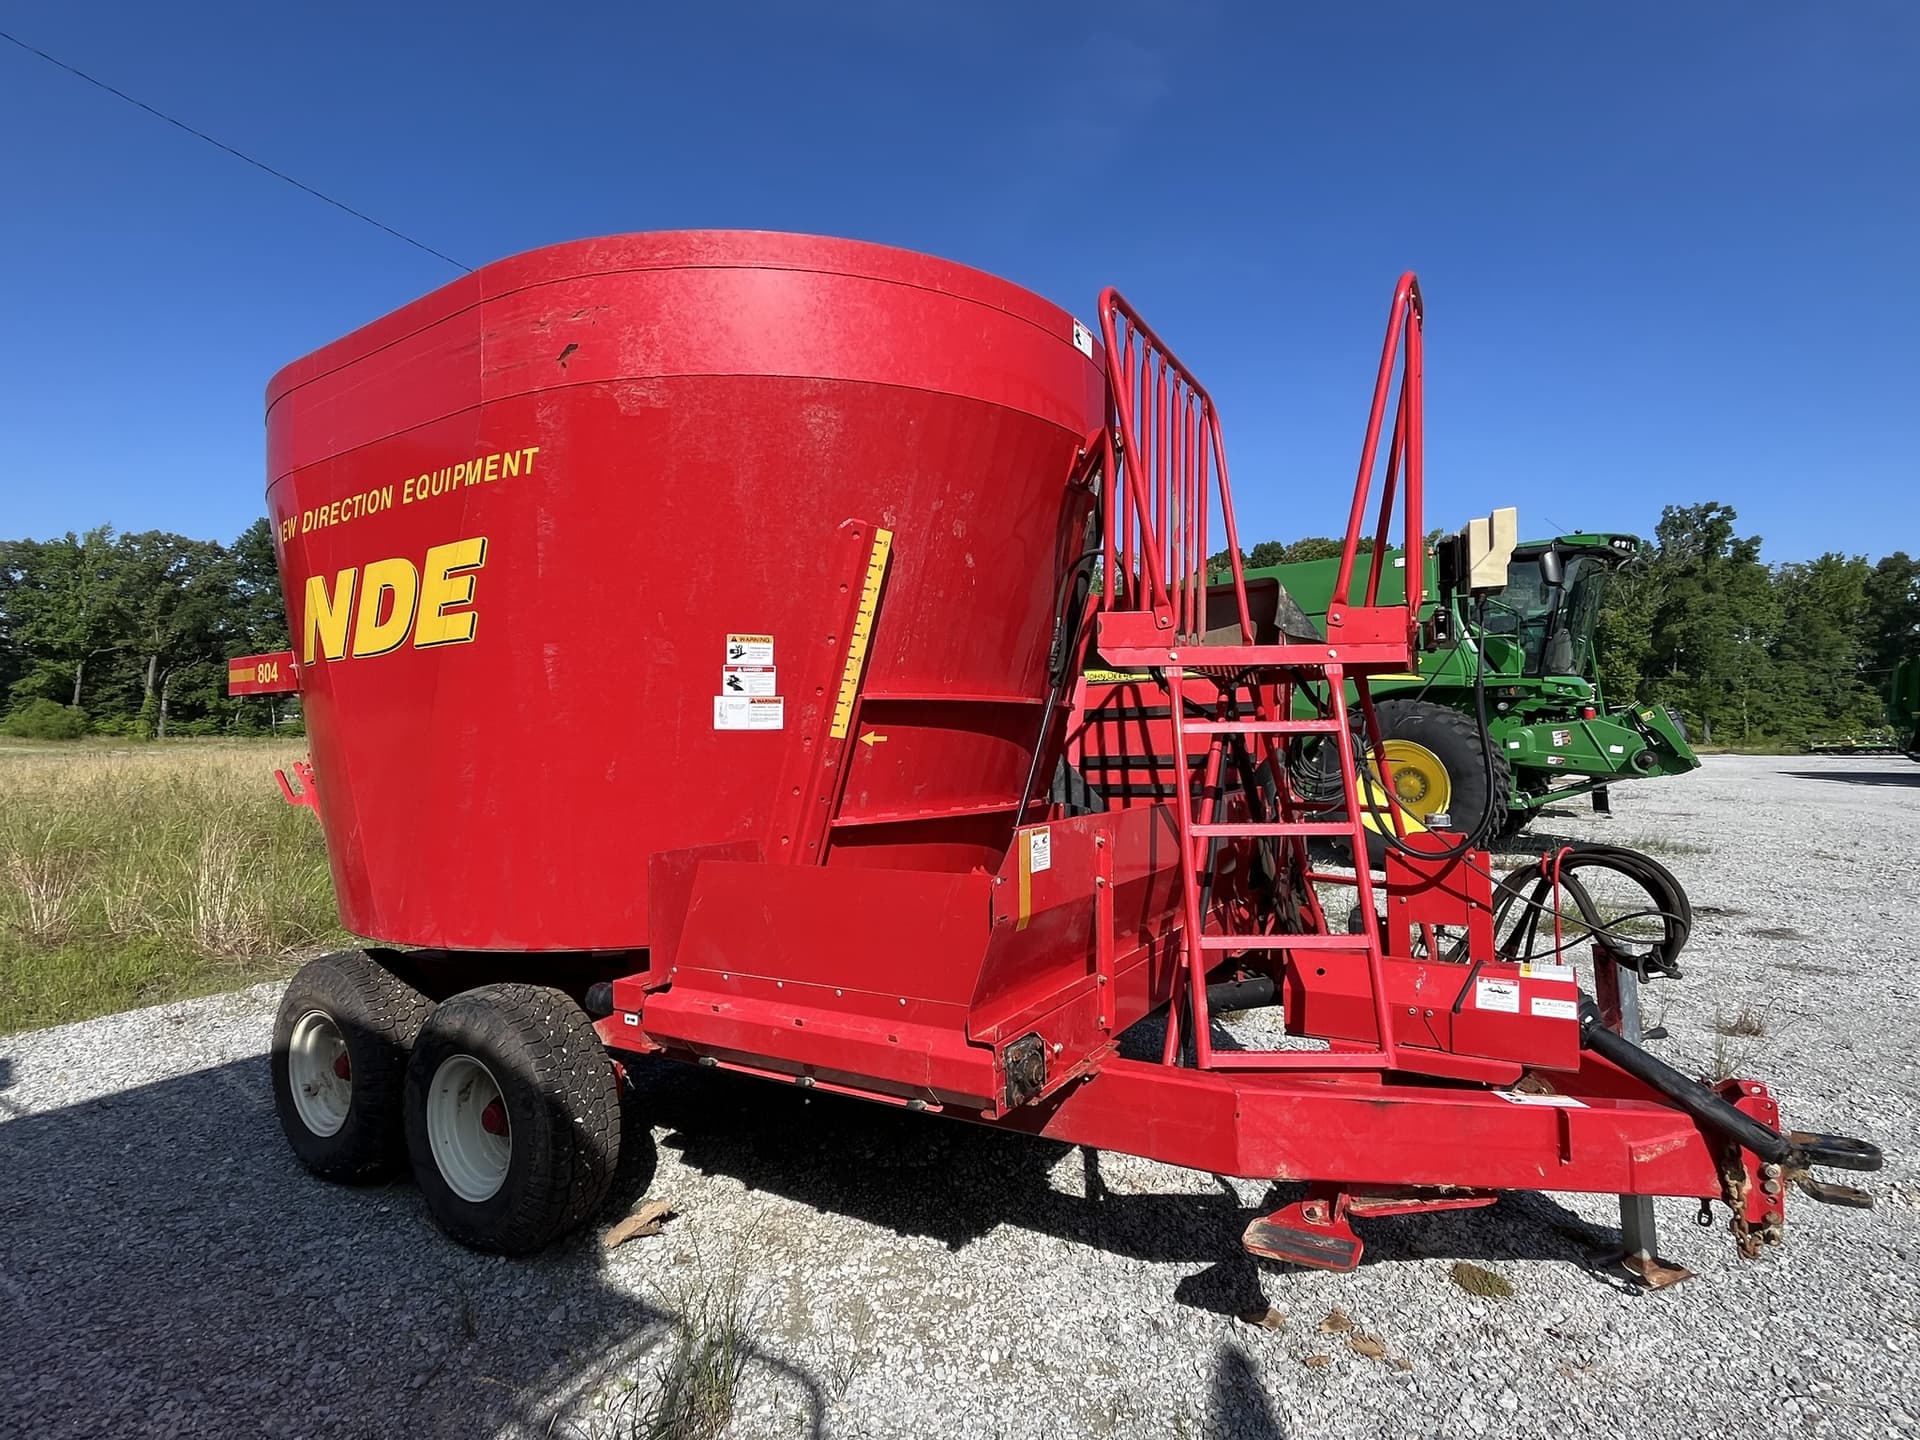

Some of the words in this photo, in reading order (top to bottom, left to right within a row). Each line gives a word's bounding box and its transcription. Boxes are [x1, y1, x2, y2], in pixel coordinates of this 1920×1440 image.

[301, 485, 394, 534] DIRECTION
[402, 446, 540, 505] EQUIPMENT
[303, 536, 488, 667] NDE
[739, 636, 771, 644] WARNING
[257, 662, 279, 684] 804
